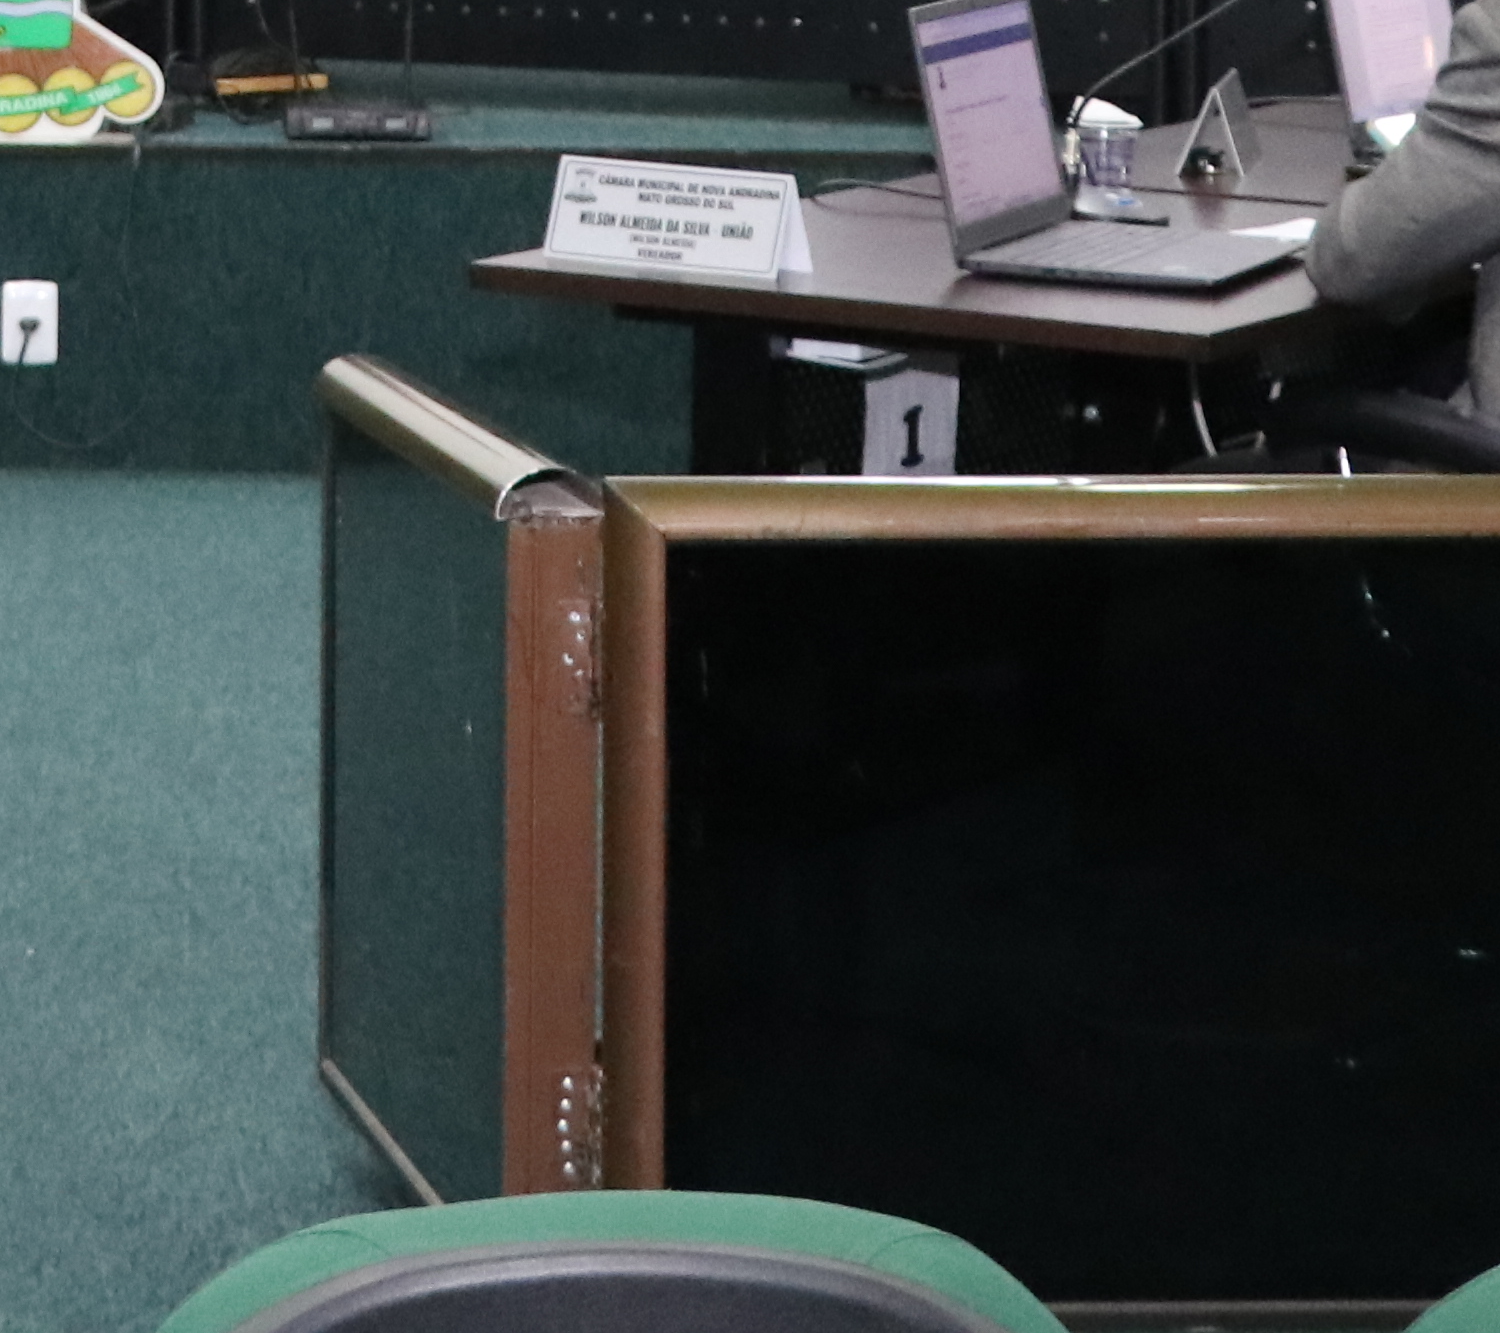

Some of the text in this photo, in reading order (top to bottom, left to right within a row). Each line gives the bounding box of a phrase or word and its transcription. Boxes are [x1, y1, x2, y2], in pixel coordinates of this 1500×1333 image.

[598, 173, 781, 199] CÂMARA MUNICIPAL DE NOVA ANDRADINA
[702, 198, 716, 208] DO
[718, 200, 734, 210] SUL
[580, 210, 616, 226] WILSON
[620, 214, 663, 231] ALMEIDA
[665, 219, 679, 233] DA
[684, 222, 710, 236] SILVA
[721, 223, 755, 240] UNIÃO
[900, 404, 924, 467] 1
